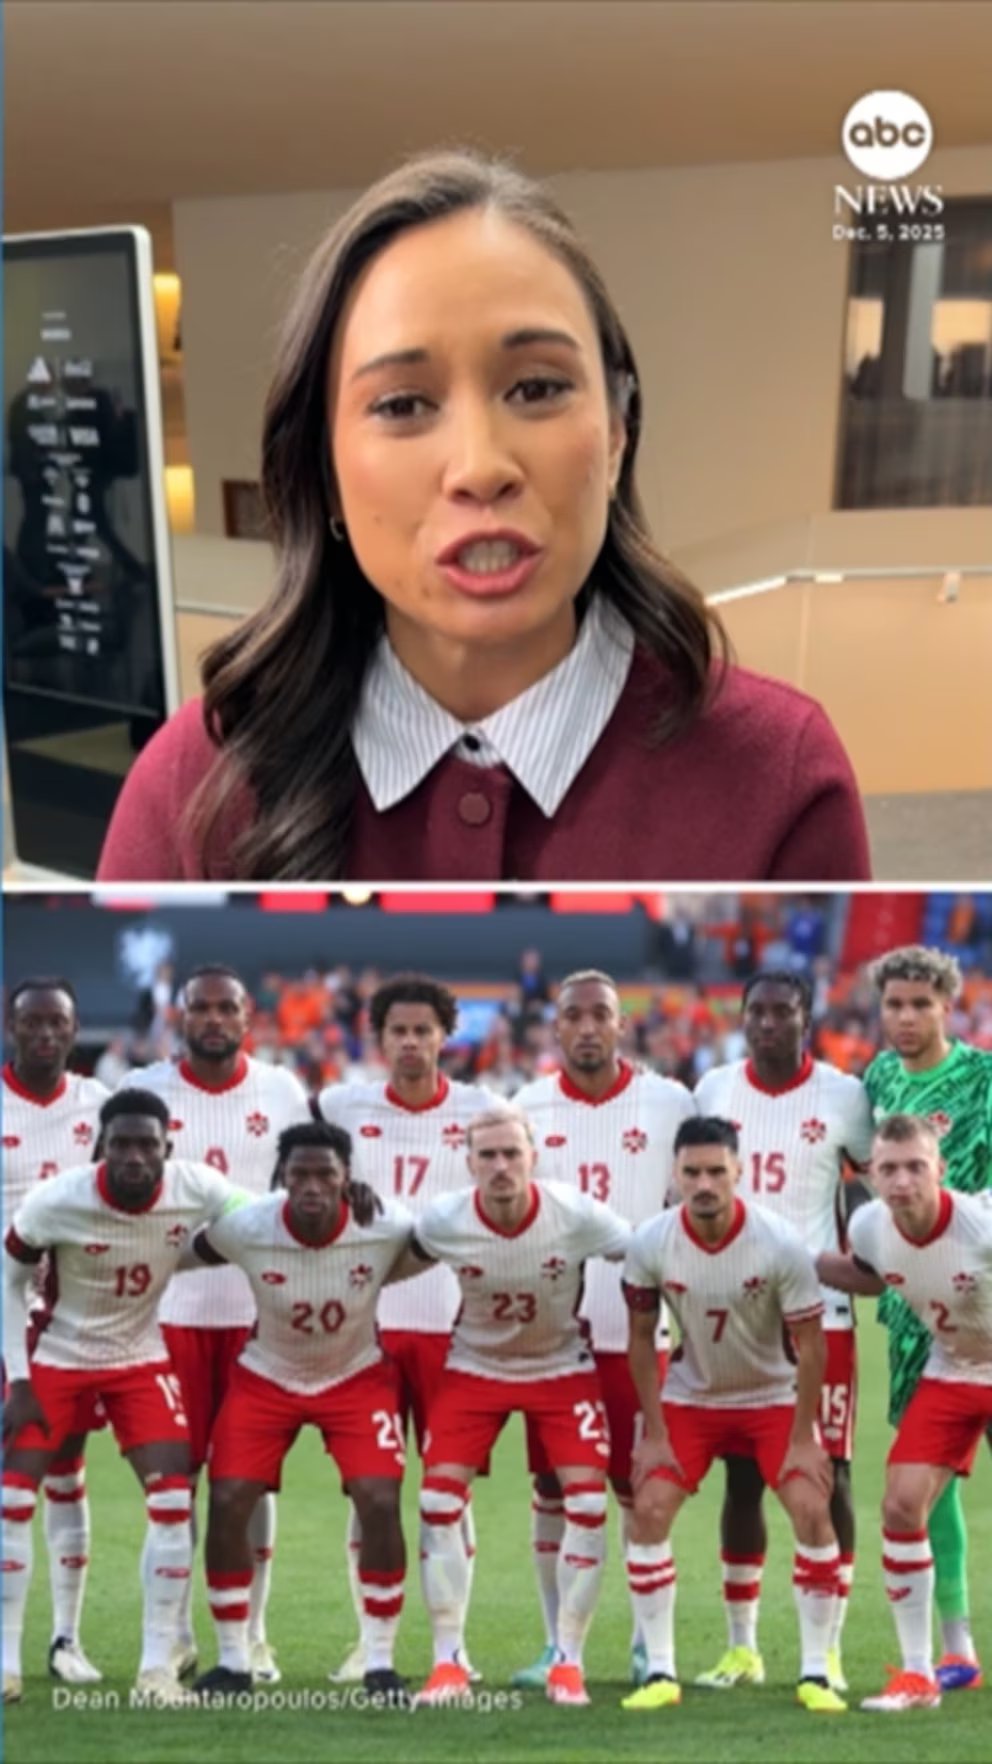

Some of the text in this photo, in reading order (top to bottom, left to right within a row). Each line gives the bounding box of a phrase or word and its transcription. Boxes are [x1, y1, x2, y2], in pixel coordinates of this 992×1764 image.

[394, 1155, 431, 1196] 17
[578, 1163, 611, 1202] 13
[752, 1152, 786, 1192] 15
[114, 1263, 152, 1297] 19
[291, 1300, 346, 1334] 20
[492, 1292, 538, 1323] 23
[930, 1301, 958, 1332] 2
[706, 1309, 729, 1343] 7
[821, 1384, 848, 1425] 15
